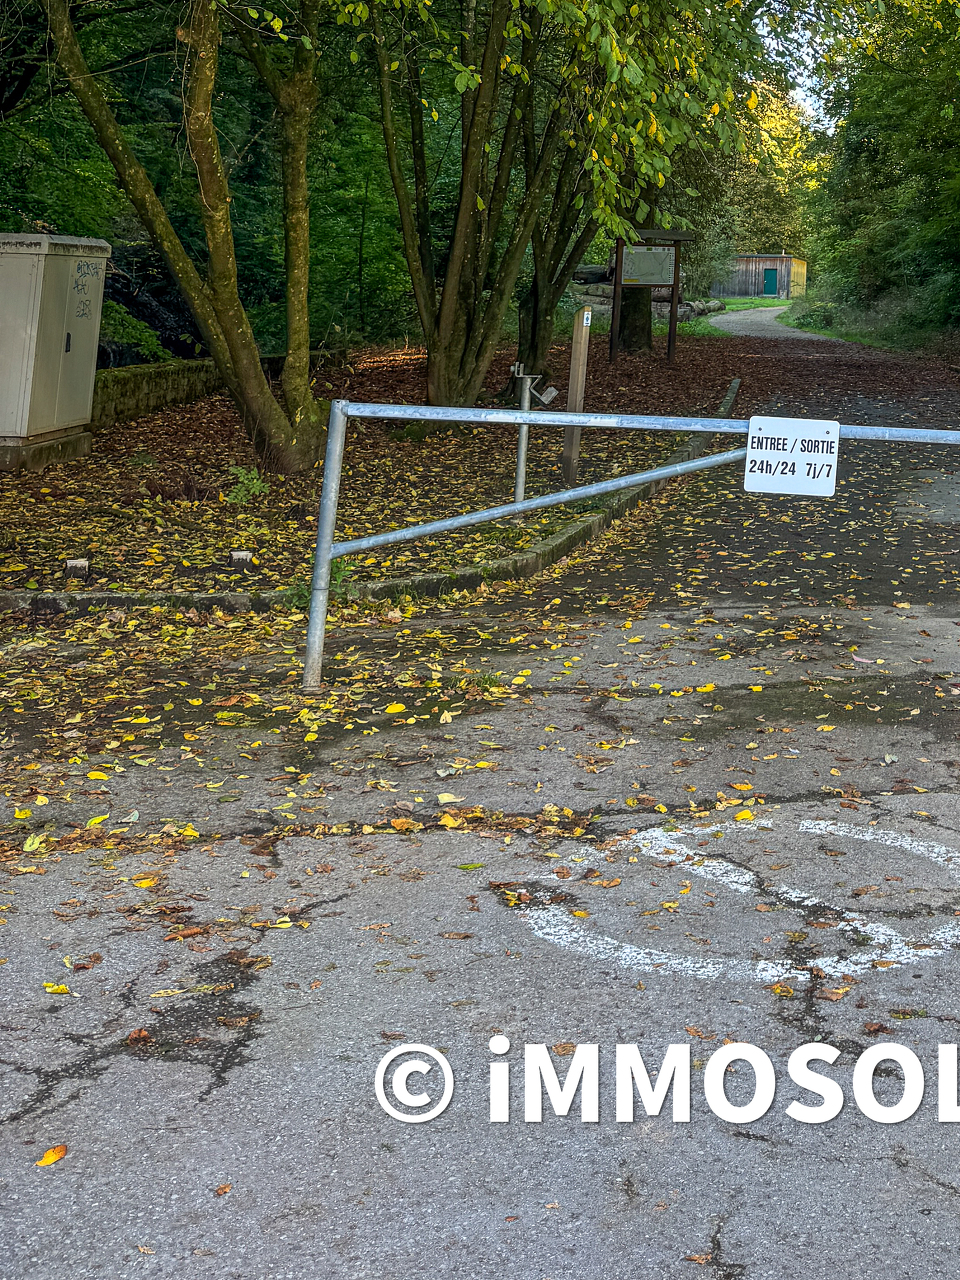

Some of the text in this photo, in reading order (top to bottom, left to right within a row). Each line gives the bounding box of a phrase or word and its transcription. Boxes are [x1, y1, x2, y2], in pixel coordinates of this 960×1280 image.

[750, 435, 788, 452] ENTREE
[800, 438, 836, 455] SORTIE
[748, 459, 833, 480] 24h/24 7j/7
